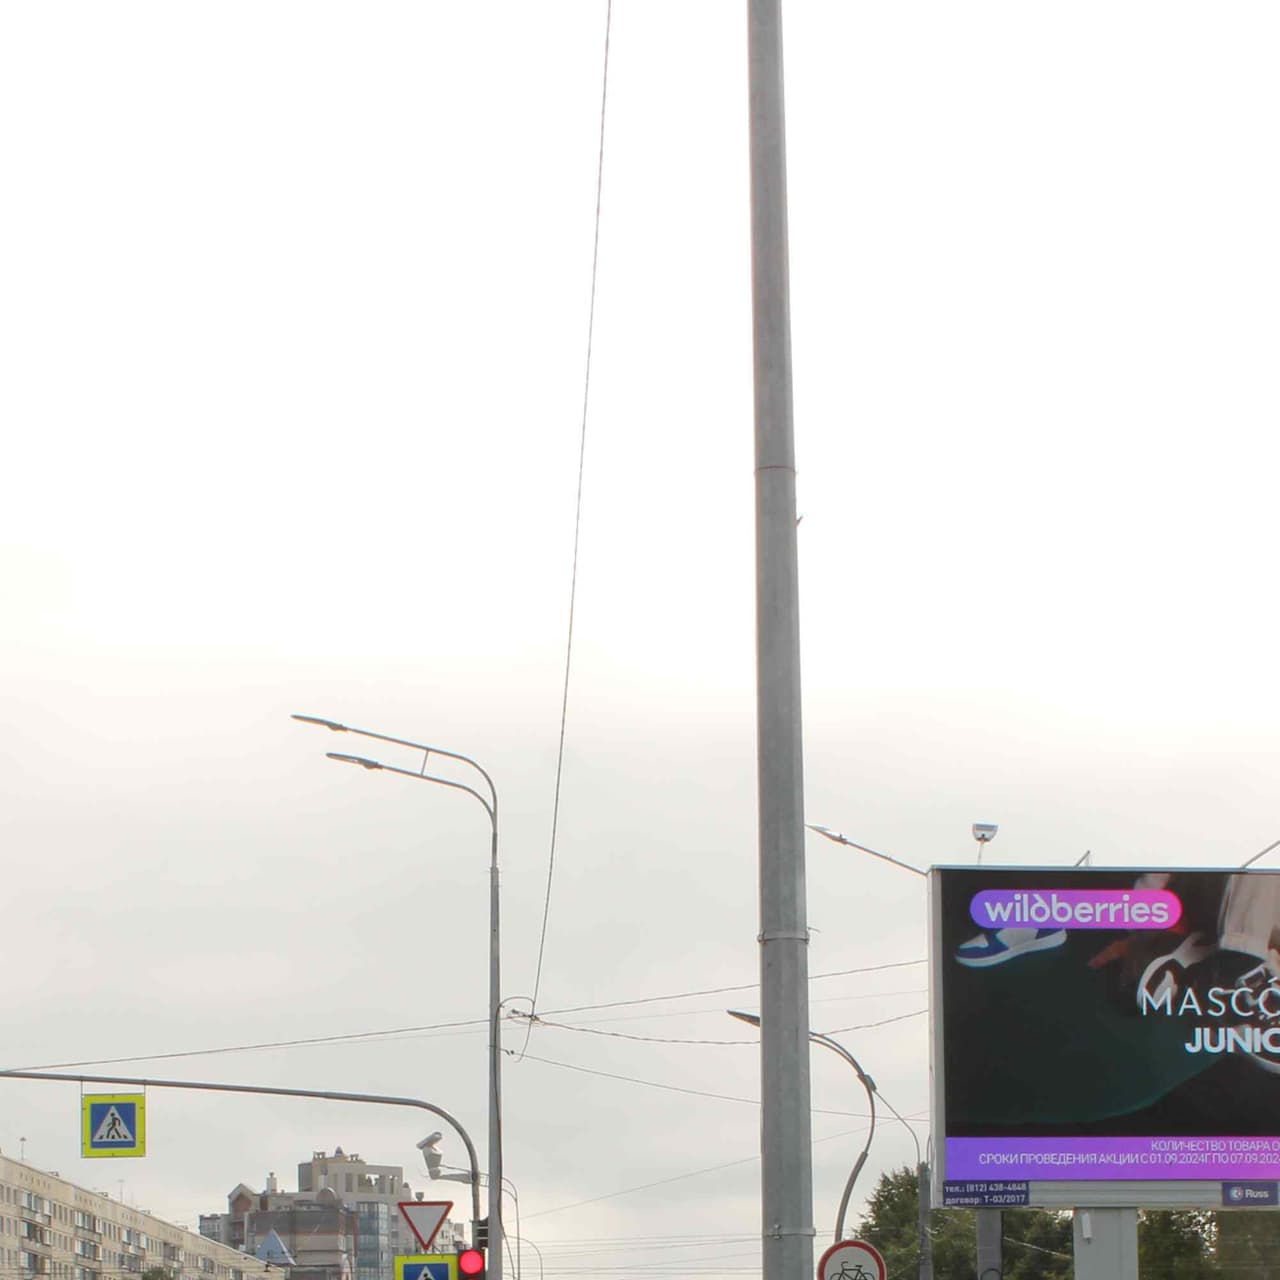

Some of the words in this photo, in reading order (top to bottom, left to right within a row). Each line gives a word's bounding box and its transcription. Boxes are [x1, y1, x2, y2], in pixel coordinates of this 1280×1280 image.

[984, 893, 1169, 923] wildberries
[1151, 1141, 1226, 1151] КОЛИЧЕСТВО
[1228, 1141, 1270, 1151] ТОВАРА
[979, 1153, 1018, 1165] СРОКИ
[1020, 1153, 1097, 1166] ПРОВЕДЕНИЯ
[1098, 1153, 1139, 1166] АКЦИИ
